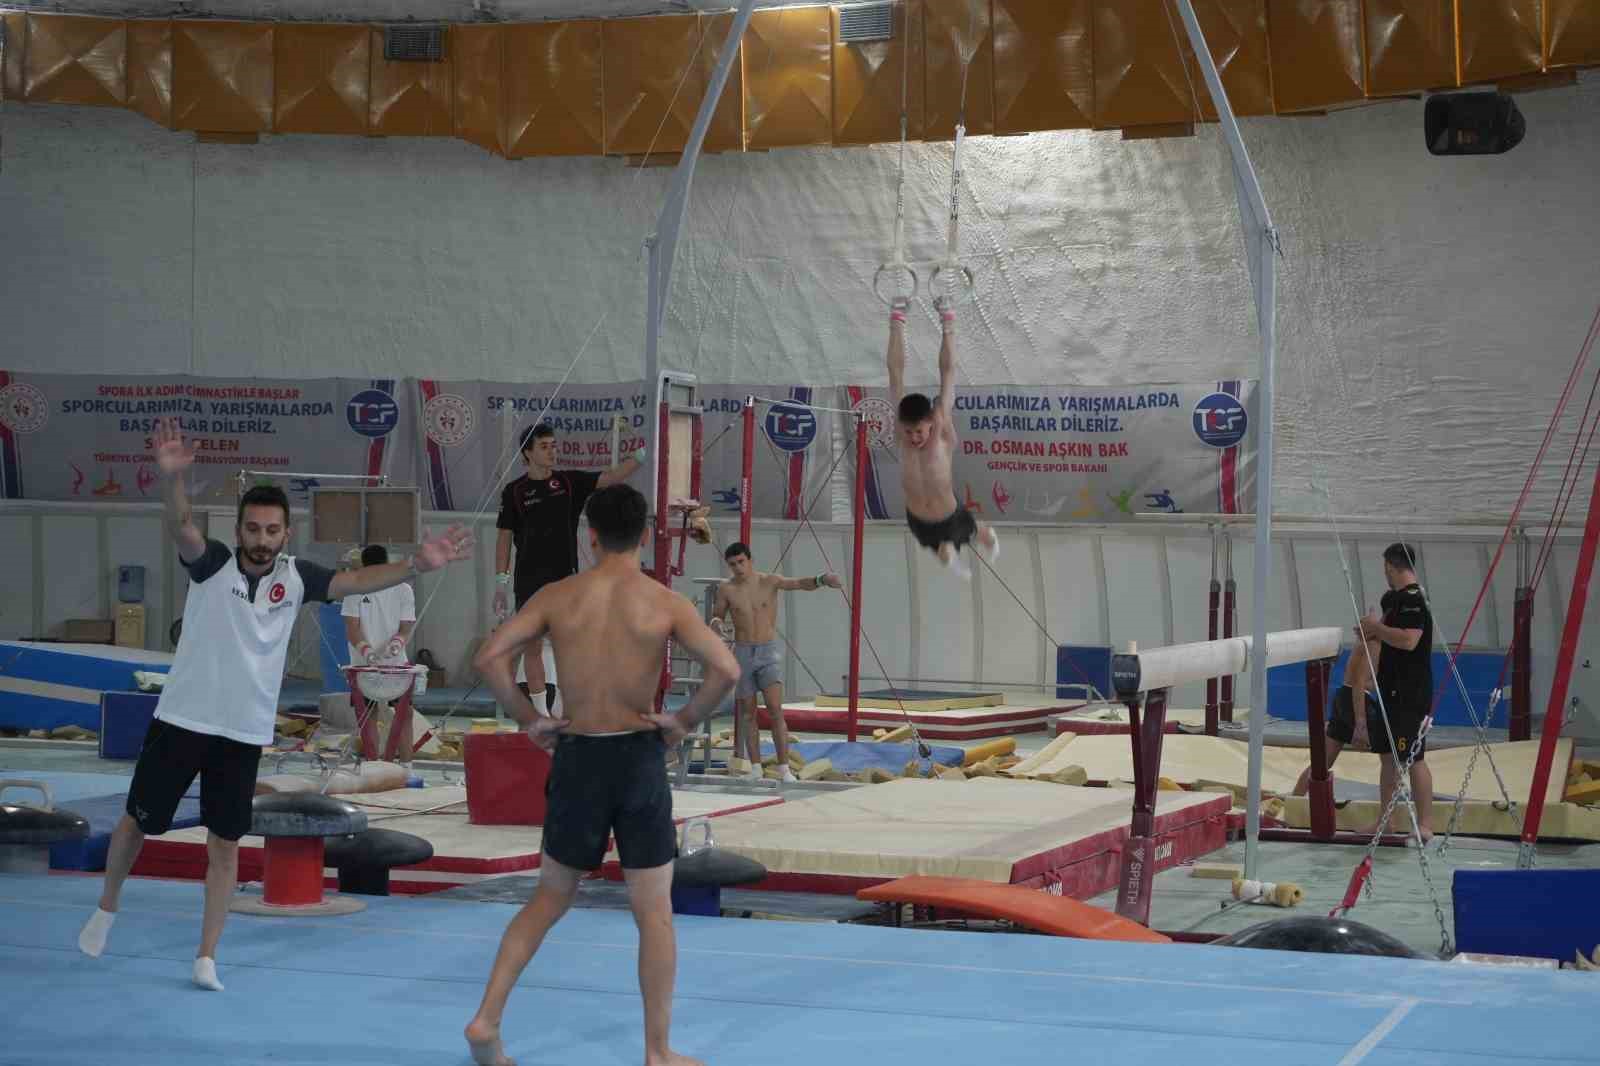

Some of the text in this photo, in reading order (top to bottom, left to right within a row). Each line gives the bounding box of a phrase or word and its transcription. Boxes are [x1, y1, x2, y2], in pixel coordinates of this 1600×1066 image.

[62, 399, 335, 417] SPORCULARIMIZA YARIŞMALARDA
[1058, 393, 1180, 415] YARIŞMALARDA
[212, 417, 277, 434] DİLERİZ.
[970, 414, 1124, 434] BAŞARILAR DİLERİZ.
[963, 440, 1129, 460] DR. OSMAN AŞKIN BAK
[1043, 463, 1070, 473] SPOR
[1128, 861, 1142, 905] SPIETH
